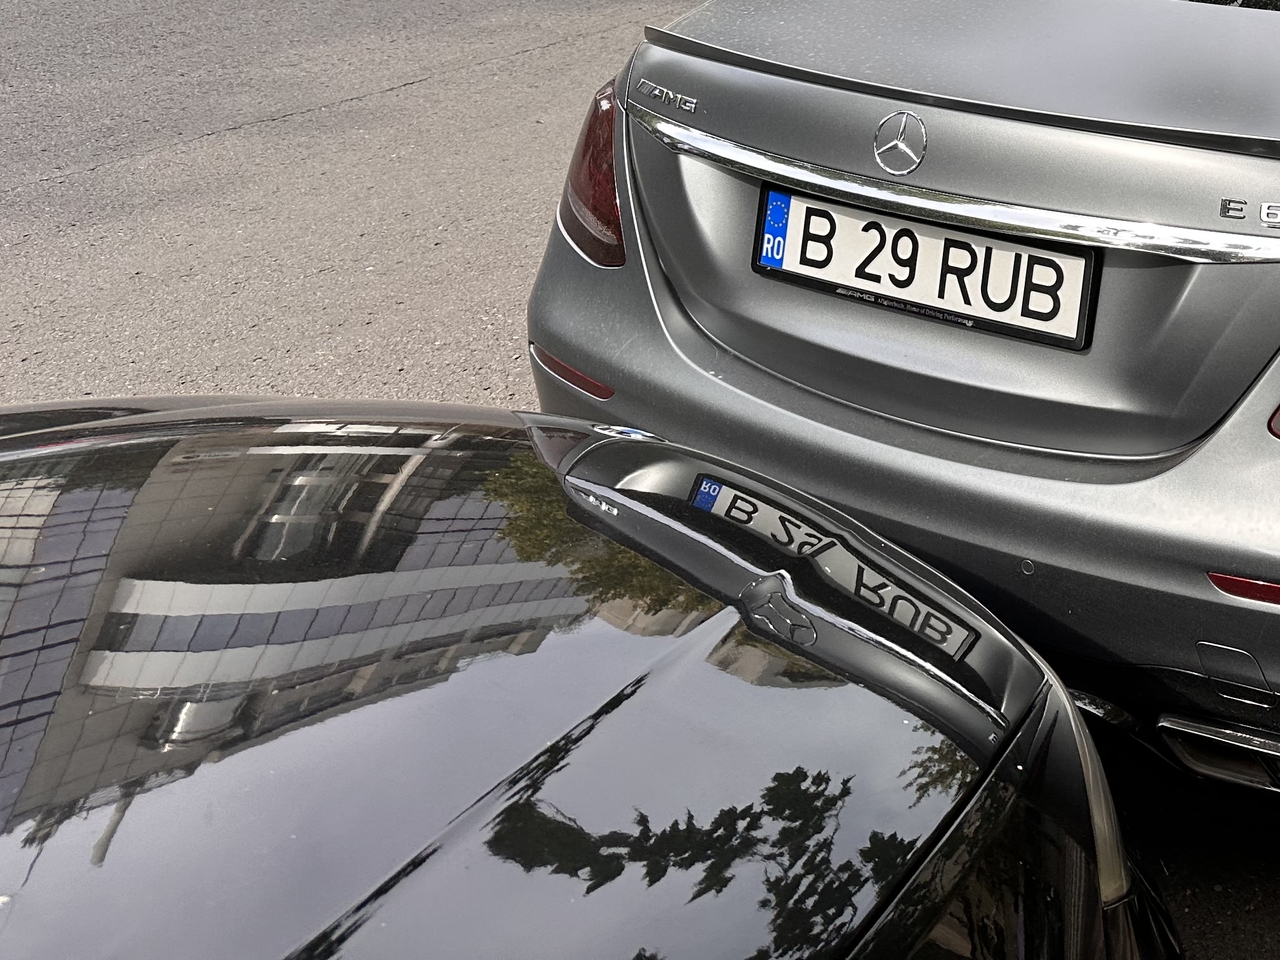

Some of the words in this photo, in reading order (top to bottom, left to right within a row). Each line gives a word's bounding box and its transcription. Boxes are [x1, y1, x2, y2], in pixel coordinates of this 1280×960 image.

[651, 87, 698, 113] AMG
[1220, 197, 1247, 219] E
[763, 233, 784, 260] RO
[800, 206, 837, 269] B
[854, 221, 919, 289] 29
[937, 237, 1064, 322] RUB
[847, 290, 875, 302] AMG
